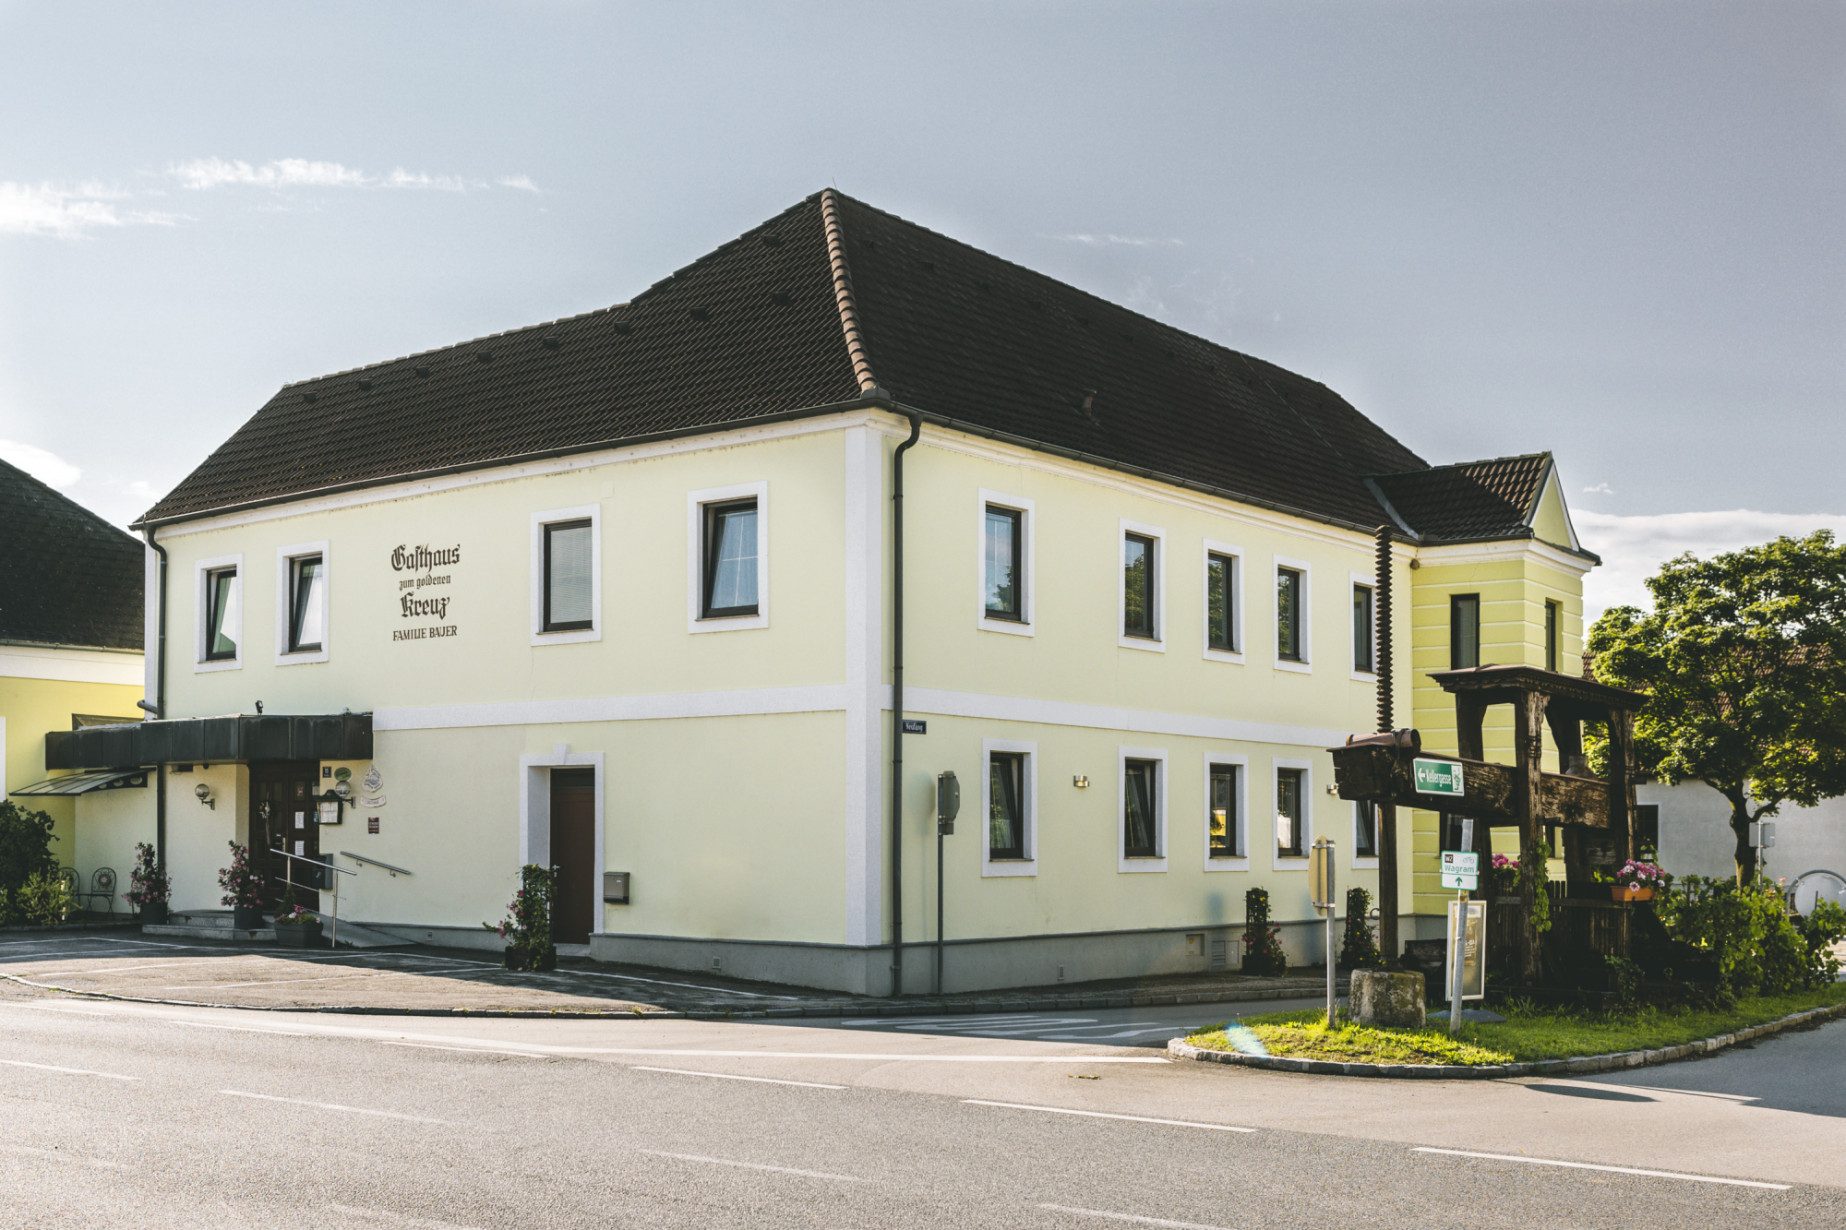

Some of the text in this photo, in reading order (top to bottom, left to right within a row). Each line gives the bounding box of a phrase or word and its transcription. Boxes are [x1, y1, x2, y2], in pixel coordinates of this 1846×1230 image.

[399, 574, 451, 591] zum goldenen
[400, 591, 450, 620] Kreuz
[393, 625, 457, 641] FAMILIE BAUER
[1425, 769, 1451, 787] Kellergasse
[1445, 864, 1475, 874] Wagram
